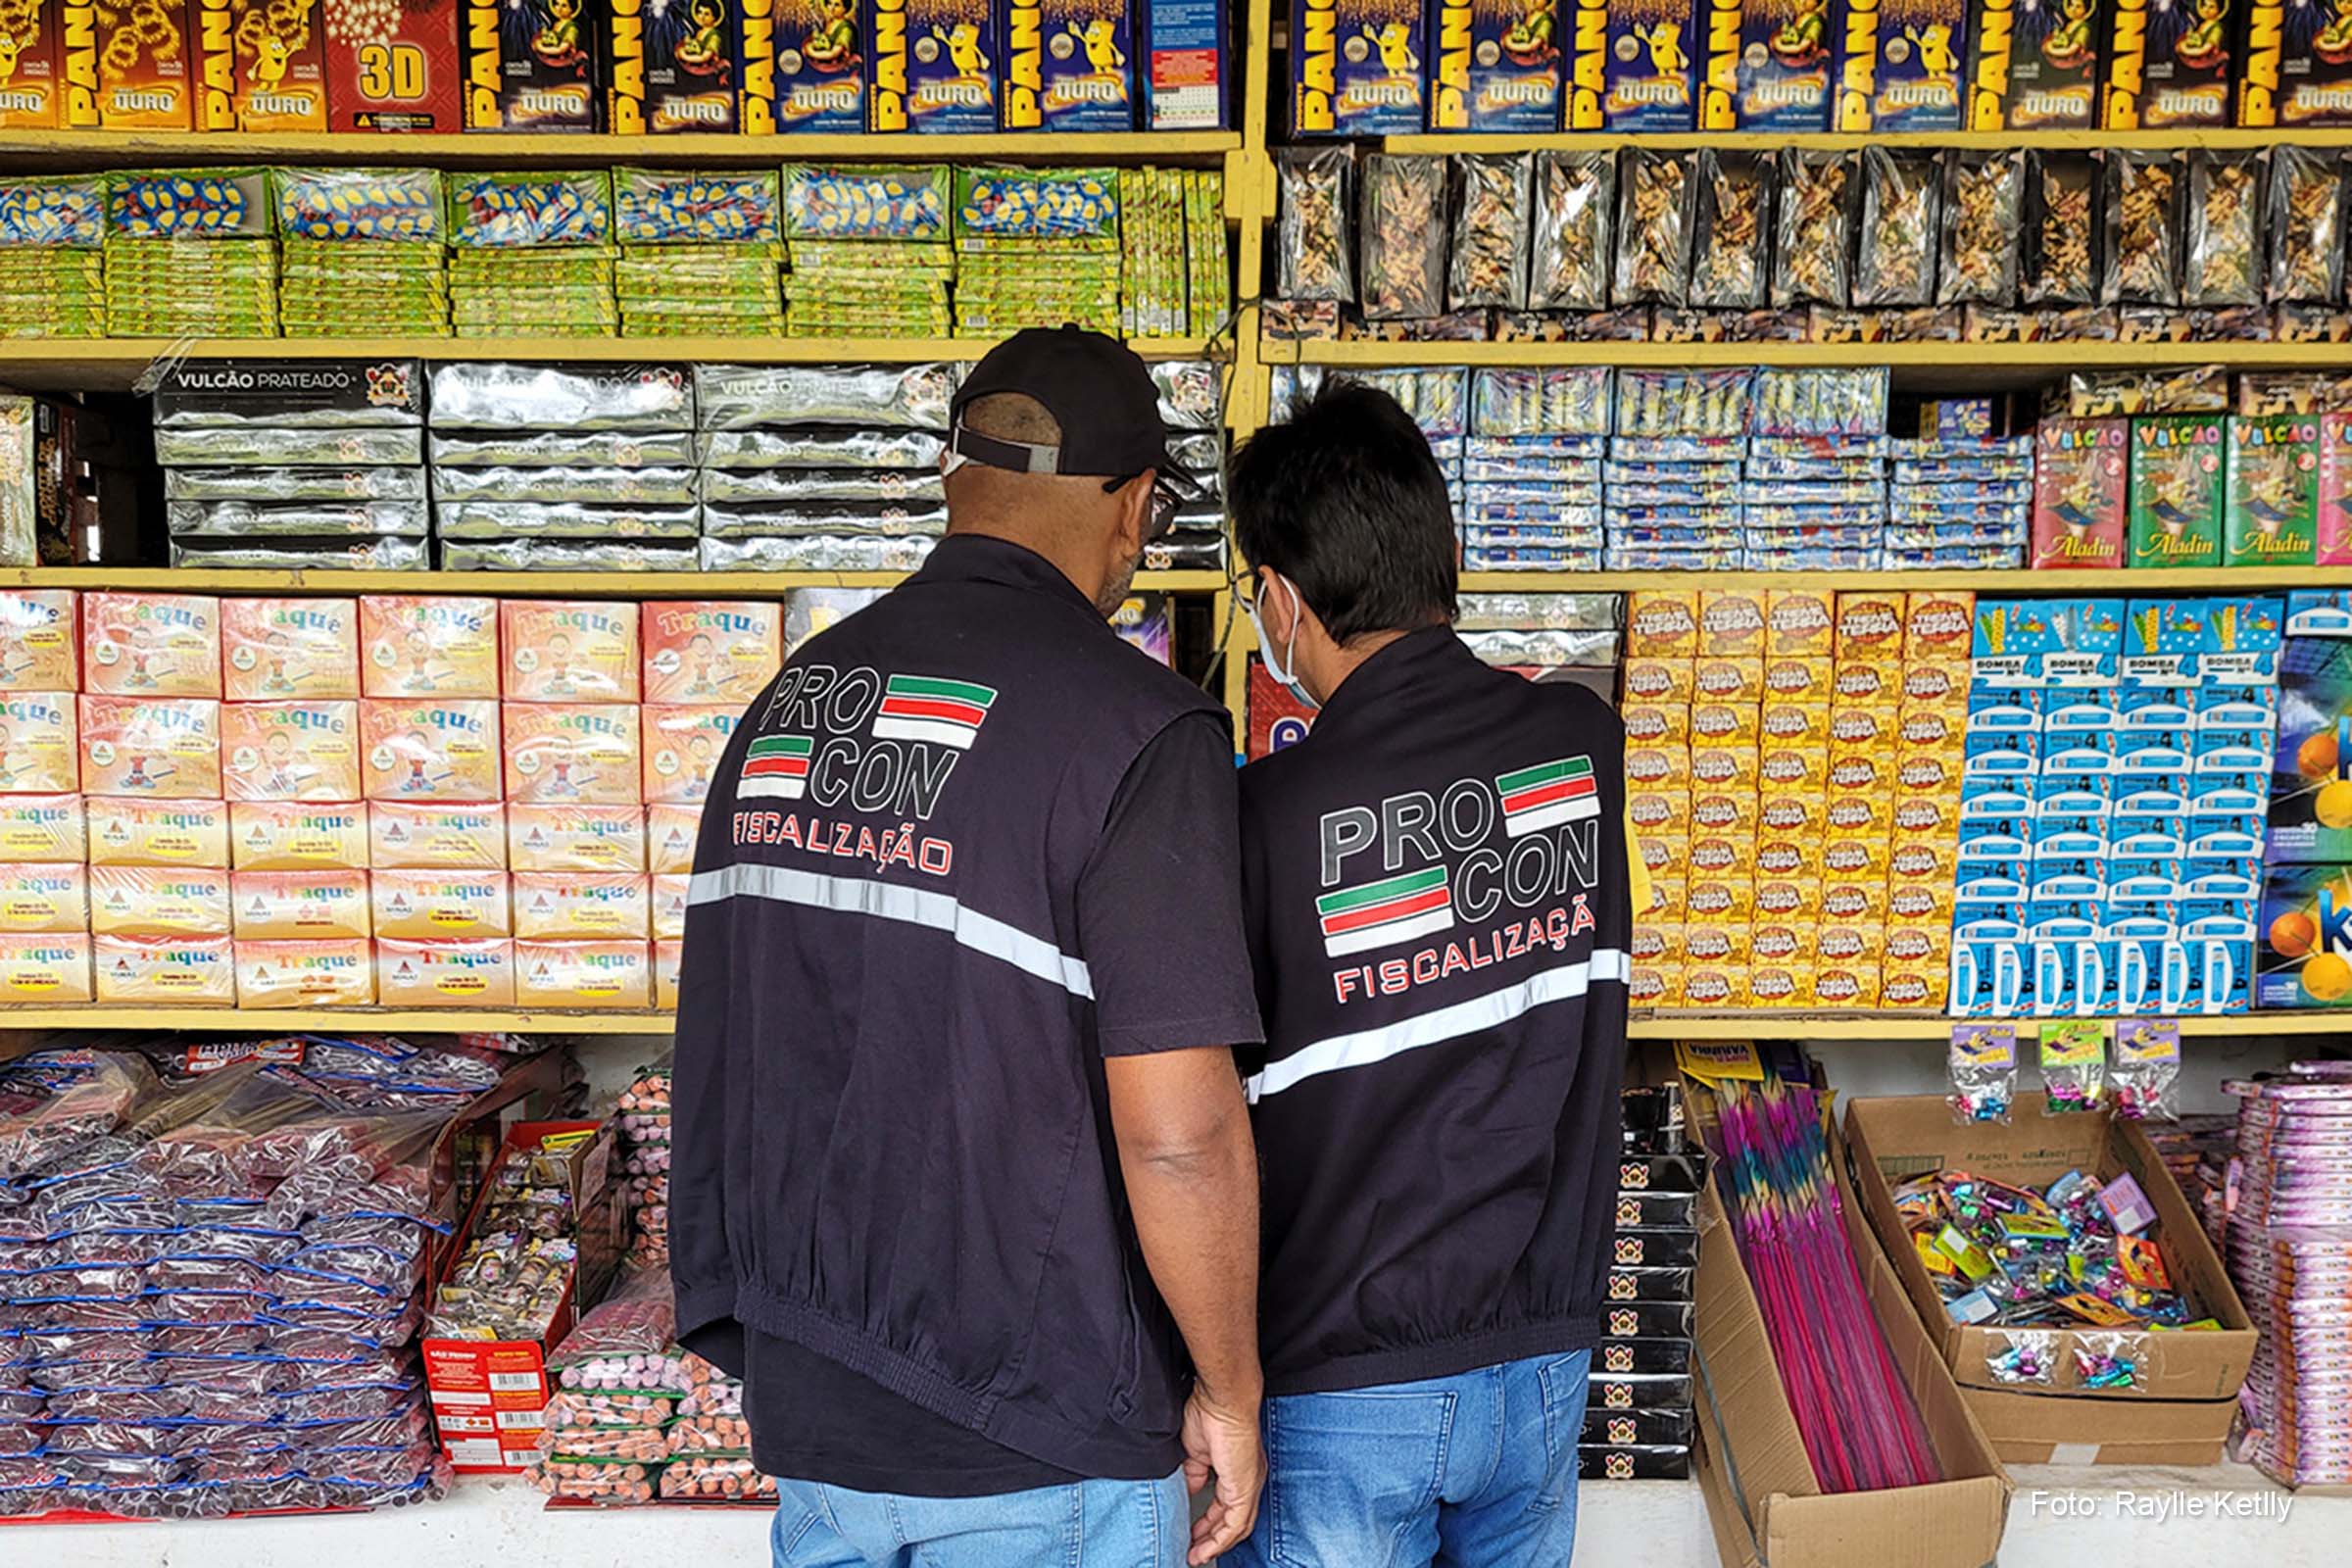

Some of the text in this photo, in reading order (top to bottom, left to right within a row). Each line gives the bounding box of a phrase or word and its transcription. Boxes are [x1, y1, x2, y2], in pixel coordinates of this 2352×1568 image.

[70, 0, 100, 125] PAN
[203, 0, 237, 130] PAN
[359, 44, 425, 99] 3D
[468, 0, 502, 127] PAN
[612, 0, 647, 134] PAN
[743, 0, 776, 133] PAN
[875, 0, 908, 131] PAN
[1010, 0, 1043, 128] PAN
[1303, 0, 1336, 130] PAN
[1440, 0, 1472, 128] PAN
[1573, 0, 1609, 128] PAN
[1705, 0, 1742, 130] PAN
[1841, 0, 1880, 131] PAN
[1974, 0, 2015, 131] PAN
[2109, 0, 2148, 130] PAN
[2246, 0, 2285, 126] PAN
[177, 369, 349, 389] VULCÃO PRATEADO
[2039, 535, 2115, 558] Aladin
[2135, 533, 2213, 557] Aladin
[2229, 531, 2309, 555] Aladin
[517, 609, 624, 637] Traque
[658, 609, 768, 637] Traque
[373, 707, 483, 733] Traque
[517, 711, 627, 739] Traque
[759, 663, 881, 734] PRO
[810, 737, 959, 820] CON
[1320, 777, 1494, 887] PRO
[416, 882, 496, 901] Traque
[733, 810, 954, 875] FISCALIZAÇÃO
[1453, 818, 1598, 924] CON
[418, 951, 503, 968] Traque
[1334, 894, 1596, 1004] FISCALIZAÇÃ
